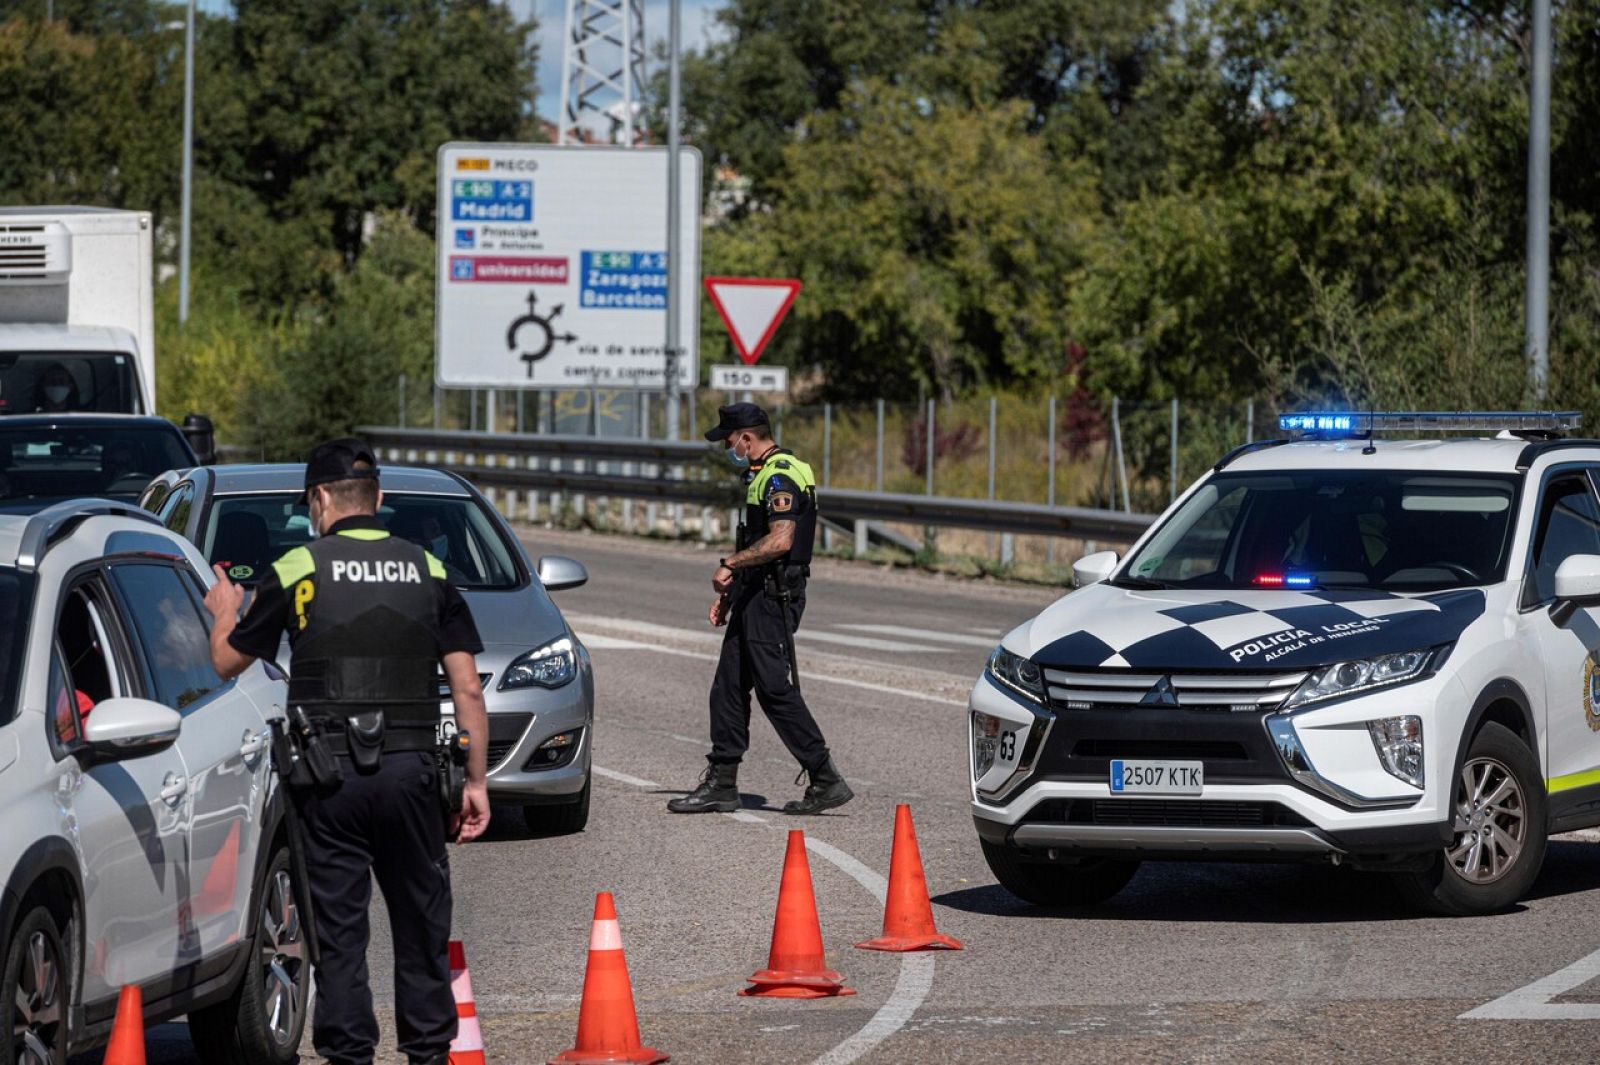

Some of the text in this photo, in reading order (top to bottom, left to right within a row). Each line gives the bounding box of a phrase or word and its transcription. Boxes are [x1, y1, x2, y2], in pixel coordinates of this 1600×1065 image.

[495, 159, 538, 171] MECO
[460, 201, 525, 218] Madrid
[478, 262, 566, 278] universidad
[584, 289, 666, 306] Barcelon
[723, 372, 776, 386] 150 m
[332, 560, 421, 583] POLICIA
[1321, 617, 1391, 633] LOCAL
[1309, 635, 1326, 644] DE
[1327, 625, 1381, 640] HENARES
[1000, 730, 1017, 761] 63
[1124, 767, 1199, 786] 2507 KTK
